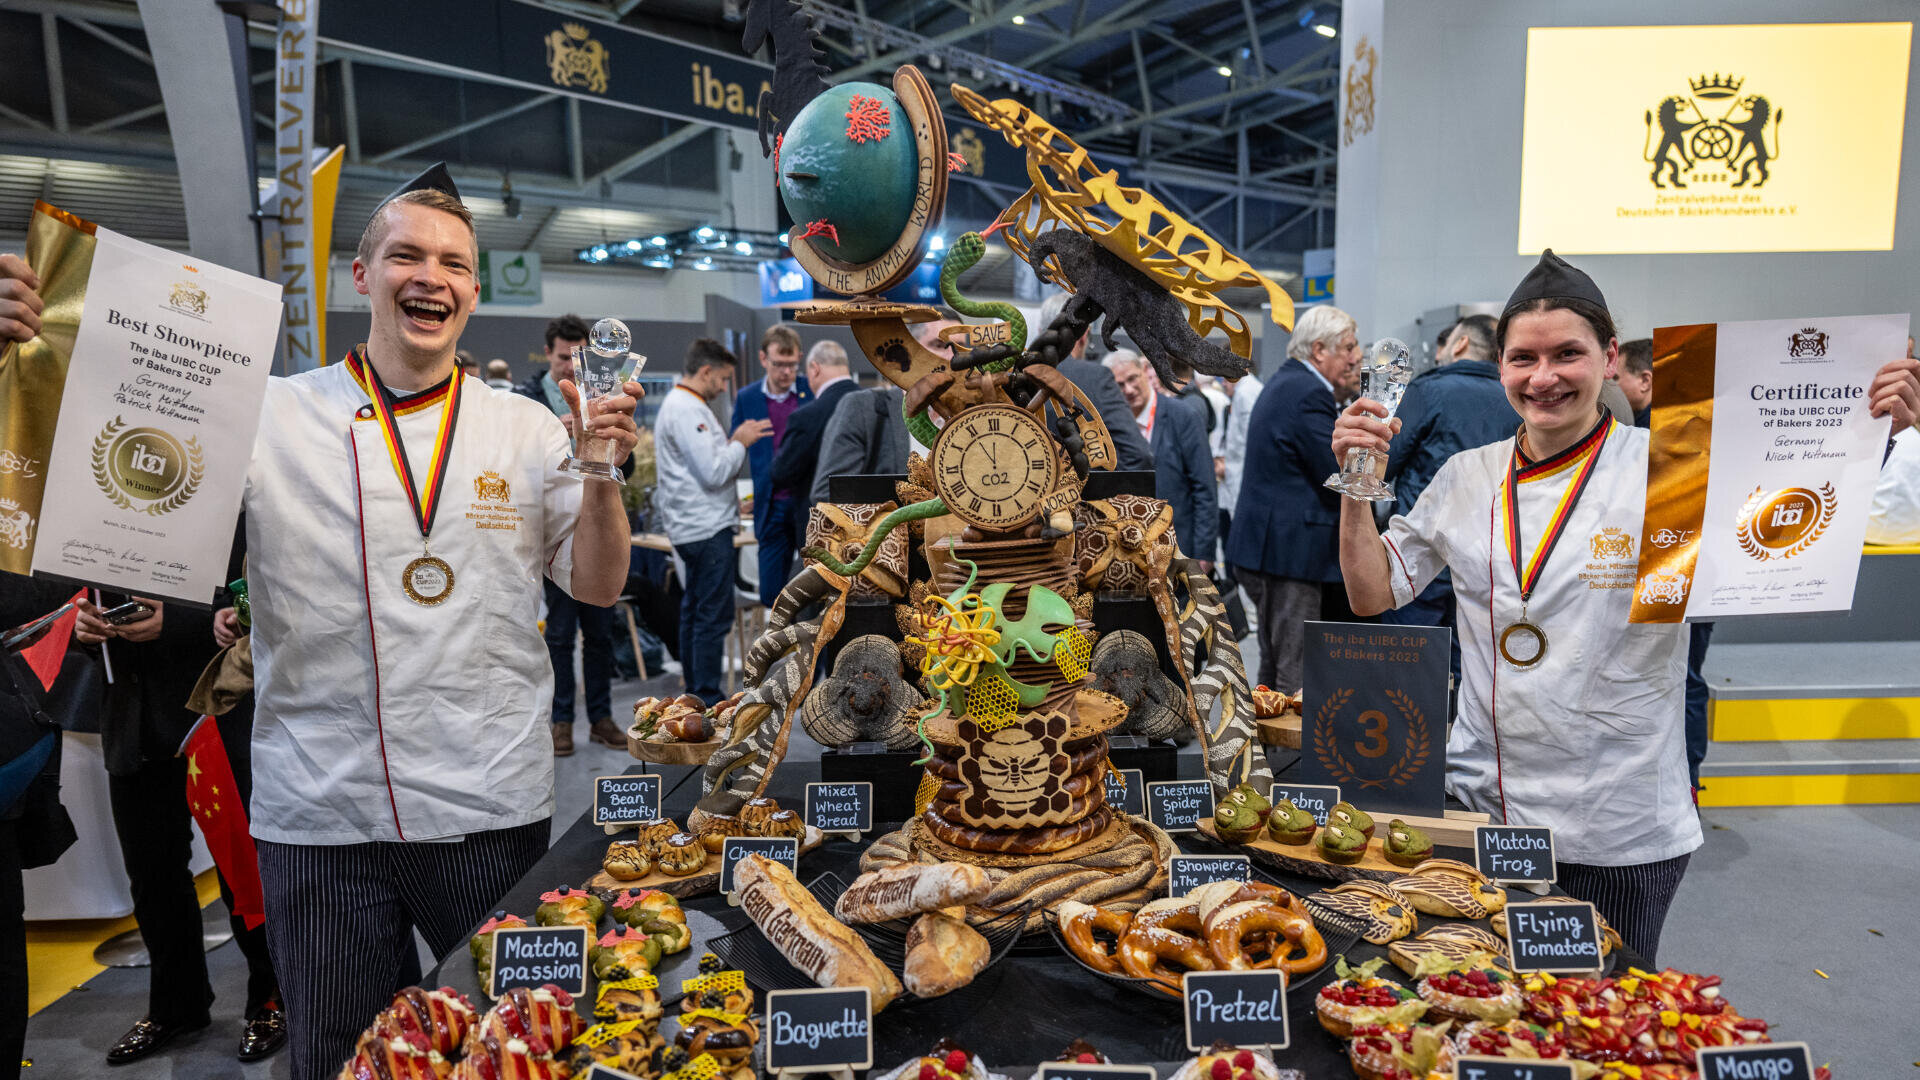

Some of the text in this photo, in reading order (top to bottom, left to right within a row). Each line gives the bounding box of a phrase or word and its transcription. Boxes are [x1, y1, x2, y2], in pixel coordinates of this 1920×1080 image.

[910, 156, 933, 227] WORLD
[1656, 194, 1761, 204] Zentralverband des
[1617, 207, 1674, 217] Deutschen
[827, 246, 910, 291] THE ANIMAL
[106, 308, 149, 335] Best
[154, 324, 251, 367] Showpiece
[973, 324, 1006, 343] SAVE
[129, 341, 221, 377] The iba UIBC CUP
[132, 357, 212, 387] of Bakers 2023
[119, 382, 152, 400] Nicole
[136, 373, 192, 402] Germany
[1751, 383, 1863, 401] Certificate
[113, 393, 152, 410] Patrick
[1759, 406, 1851, 416] The iba UIBC CUP
[1763, 418, 1843, 428] of Bakers 2023
[1083, 429, 1105, 463] OUR
[1774, 434, 1825, 451] Germany
[1765, 451, 1795, 461] Nicole
[125, 478, 163, 494] Winner
[981, 472, 1010, 487] CO2
[1043, 488, 1079, 511] WORLD
[475, 521, 516, 531] Deutschland
[1323, 632, 1344, 644] The
[1369, 634, 1398, 647] UIBC
[1401, 636, 1428, 648] CUP
[1329, 648, 1420, 663] of Bakers 2023
[1354, 709, 1389, 759] 3
[601, 780, 656, 792] Bacon-
[818, 784, 858, 797] Mixed
[1154, 783, 1210, 797] Chestnut
[610, 794, 644, 806] Bean
[815, 798, 861, 813] Wheat
[1162, 797, 1202, 813] Spider
[1279, 791, 1326, 811] Zebra
[599, 805, 657, 820] Butterfly
[816, 812, 859, 828] Bread
[1164, 810, 1200, 825] Bread
[1484, 831, 1550, 851] Matcha
[1490, 854, 1537, 877] Frog
[741, 876, 828, 981] Team Germany
[1515, 911, 1584, 939] Flying
[504, 935, 579, 959] Matcha
[1517, 938, 1598, 957] Tomatoes
[498, 960, 582, 988] passion
[1190, 988, 1282, 1023] Pretzel
[772, 1008, 868, 1049] Baguette
[1715, 1056, 1794, 1080] Mango
